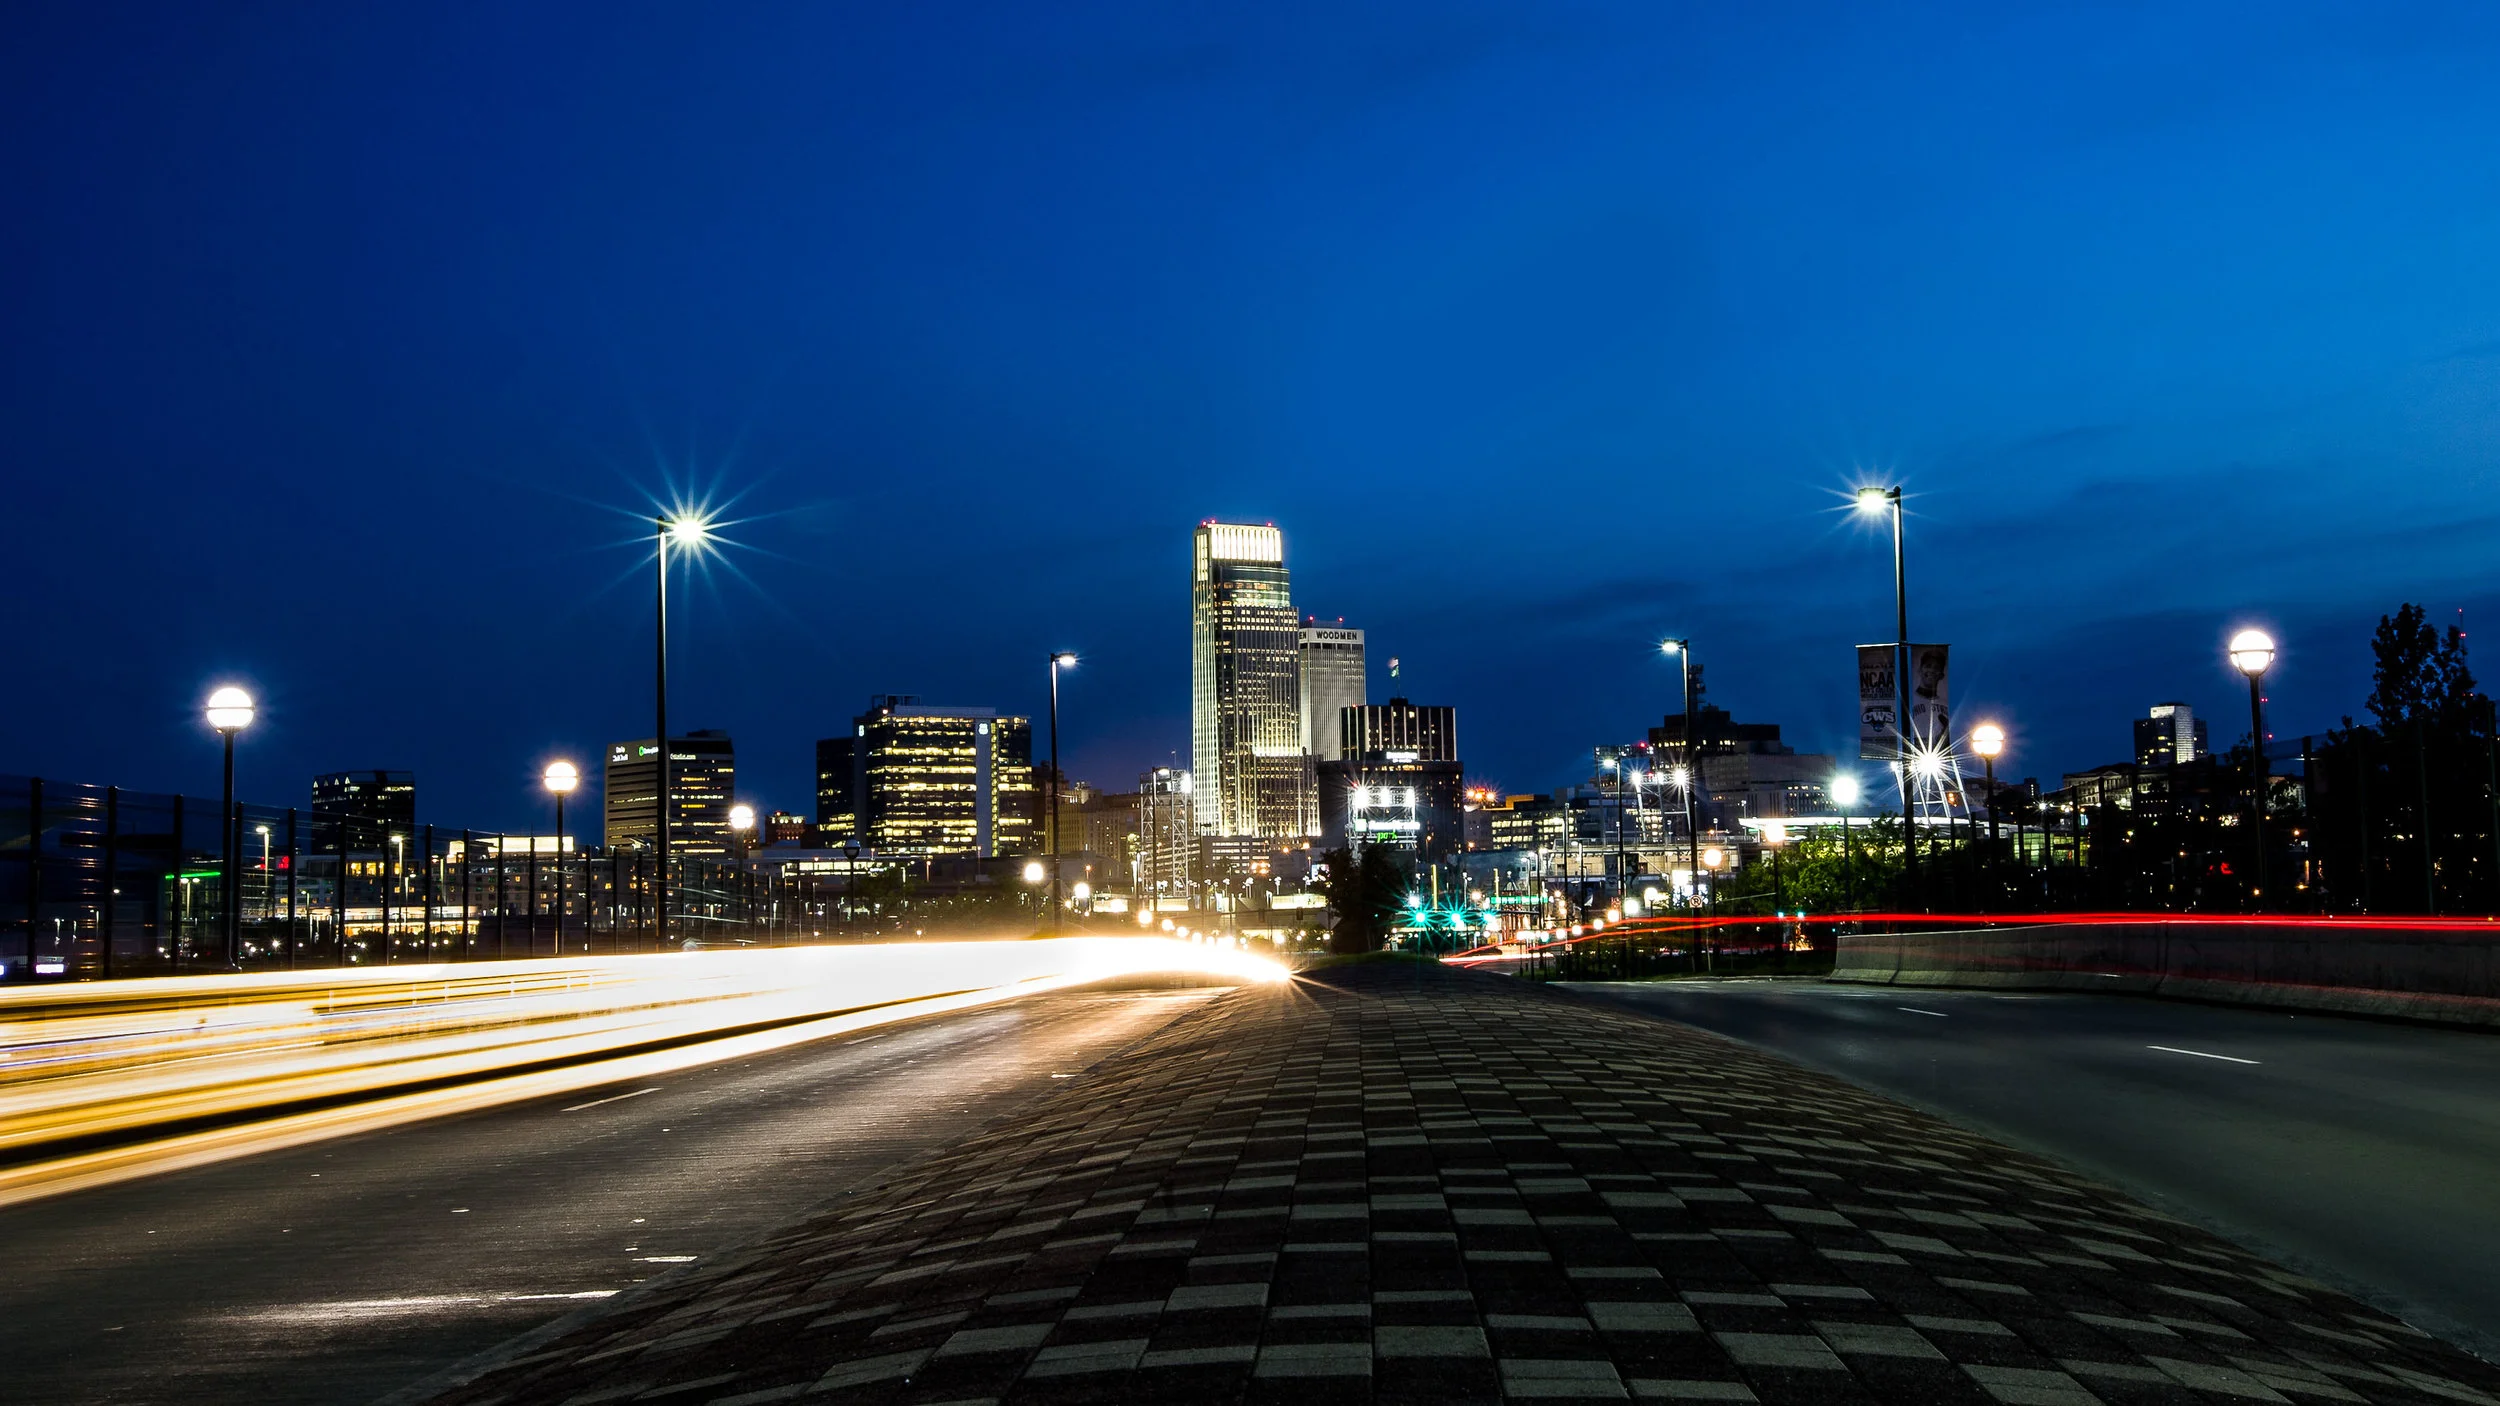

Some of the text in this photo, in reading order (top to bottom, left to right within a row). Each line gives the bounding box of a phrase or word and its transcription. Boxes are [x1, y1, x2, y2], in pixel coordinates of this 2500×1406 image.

[1316, 631, 1357, 640] WOODMEN
[1860, 671, 1895, 688] NCAA
[1862, 711, 1895, 723] CWS
